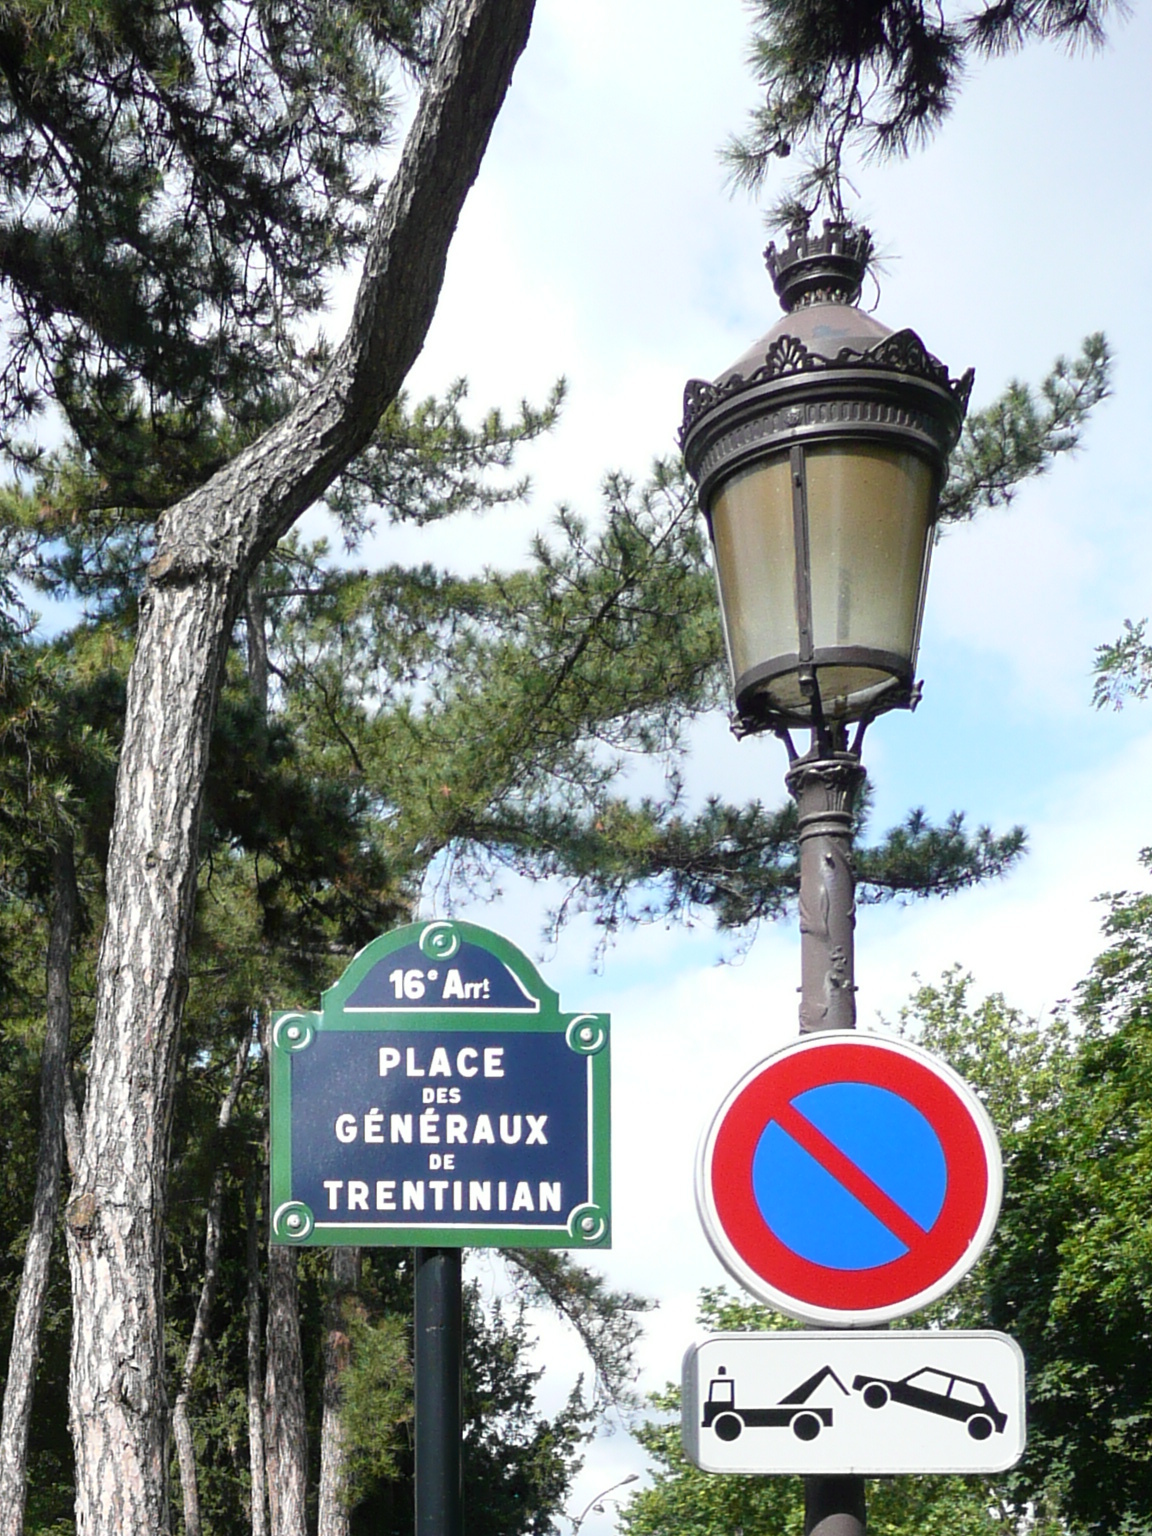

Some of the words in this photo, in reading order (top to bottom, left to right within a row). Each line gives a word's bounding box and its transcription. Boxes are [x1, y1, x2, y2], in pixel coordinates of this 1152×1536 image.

[378, 1047, 505, 1078] PLACE
[422, 1087, 461, 1104] DES
[334, 1108, 549, 1145] GÉNÉRAUX
[429, 1153, 455, 1170] DE
[323, 1180, 562, 1212] TRENTINIAN
